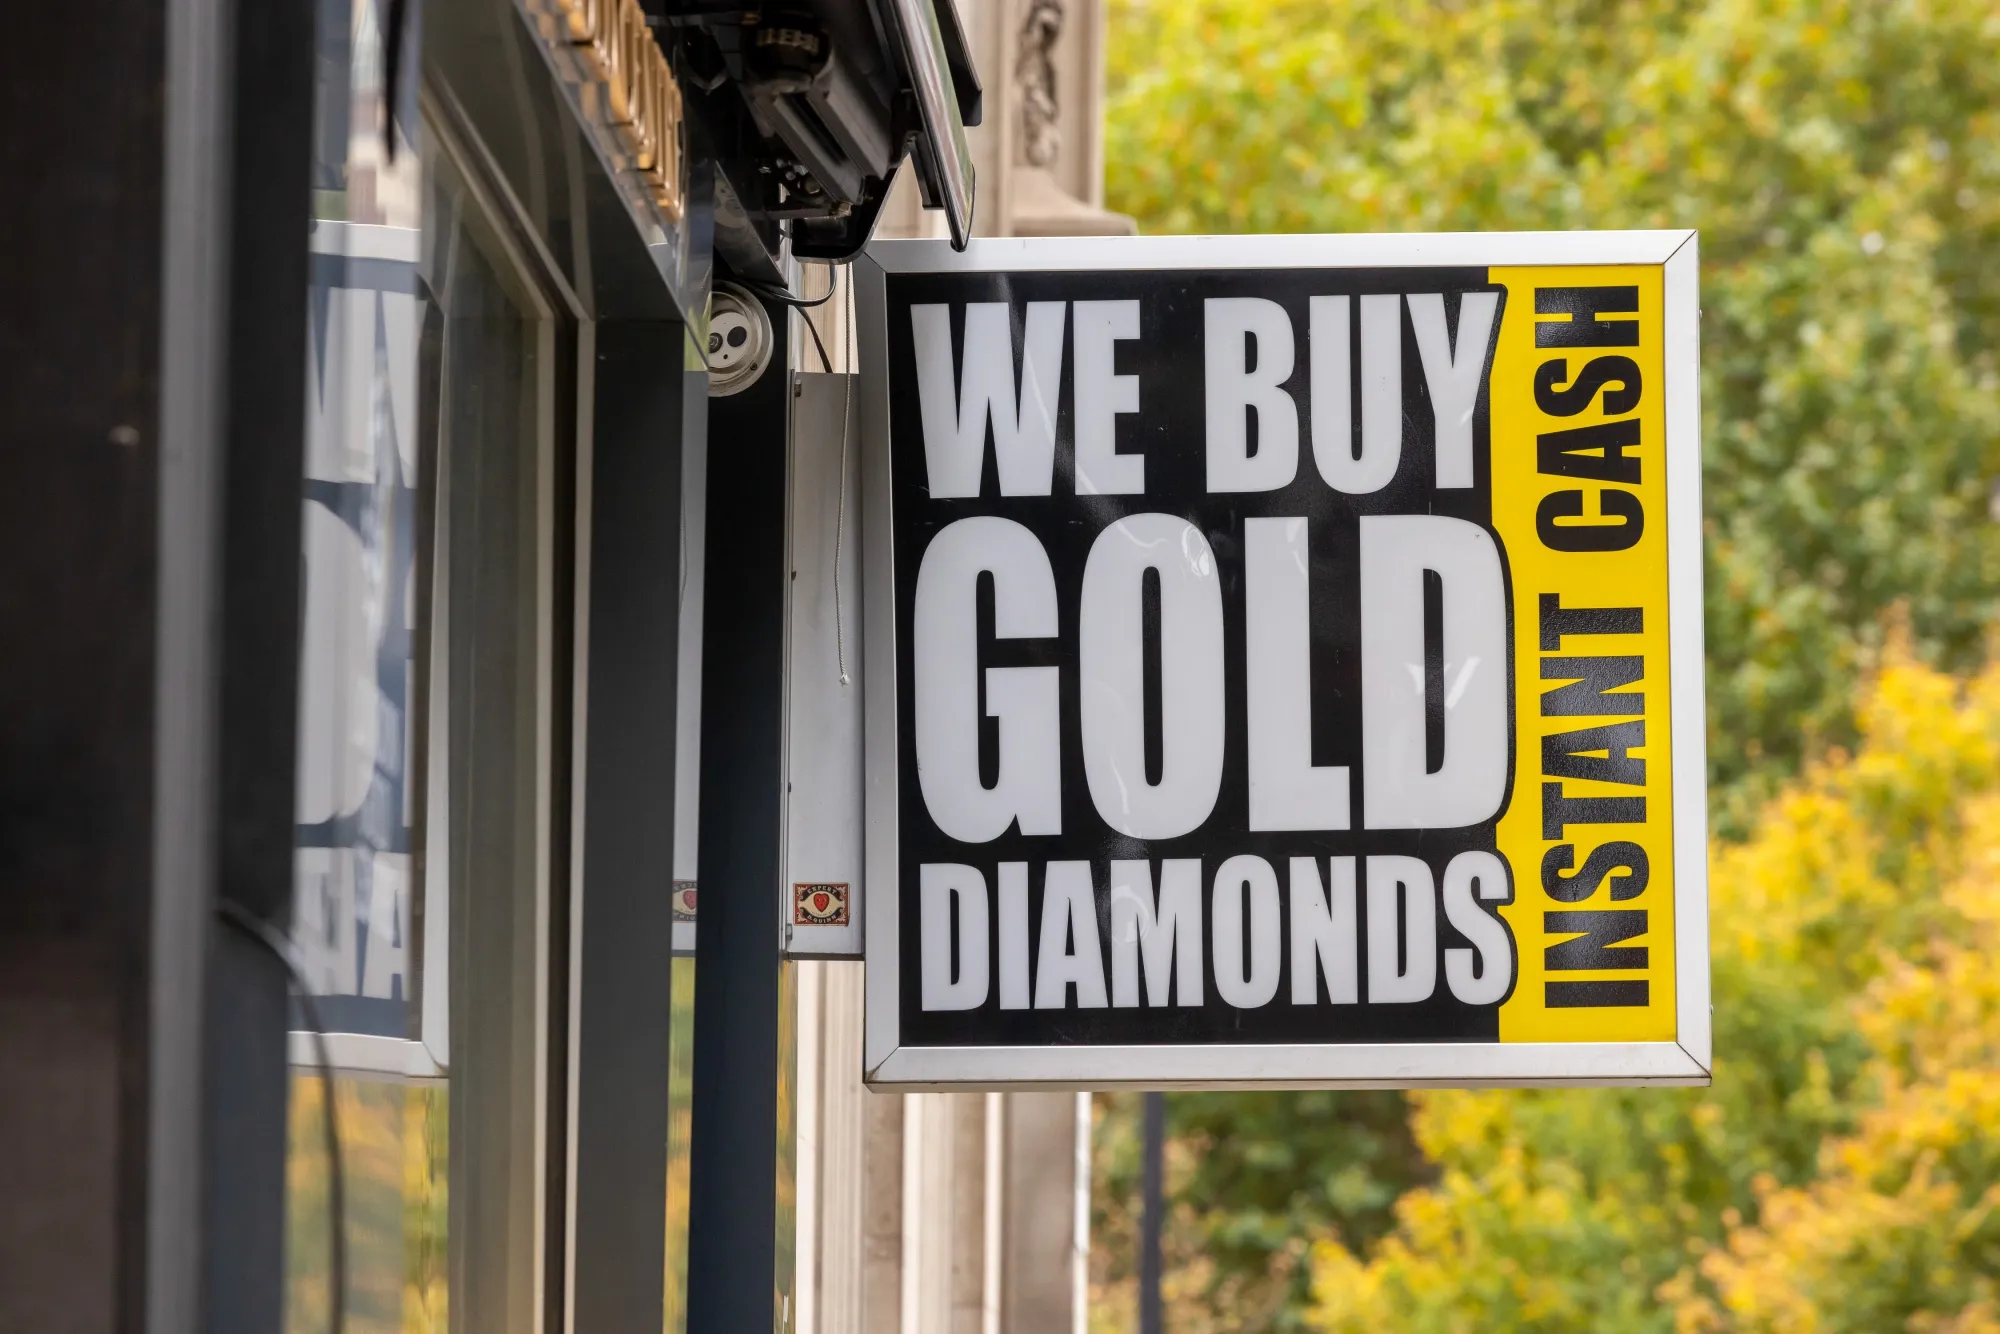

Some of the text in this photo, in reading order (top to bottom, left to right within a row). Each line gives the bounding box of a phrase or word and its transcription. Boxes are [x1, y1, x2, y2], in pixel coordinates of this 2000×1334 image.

[910, 292, 1500, 499] WE BUY
[913, 512, 1512, 843] GOLD
[1534, 285, 1650, 1009] INSTANT CASH
[807, 885, 838, 894] EXPERT
[920, 850, 1513, 1011] DIAMONDS
